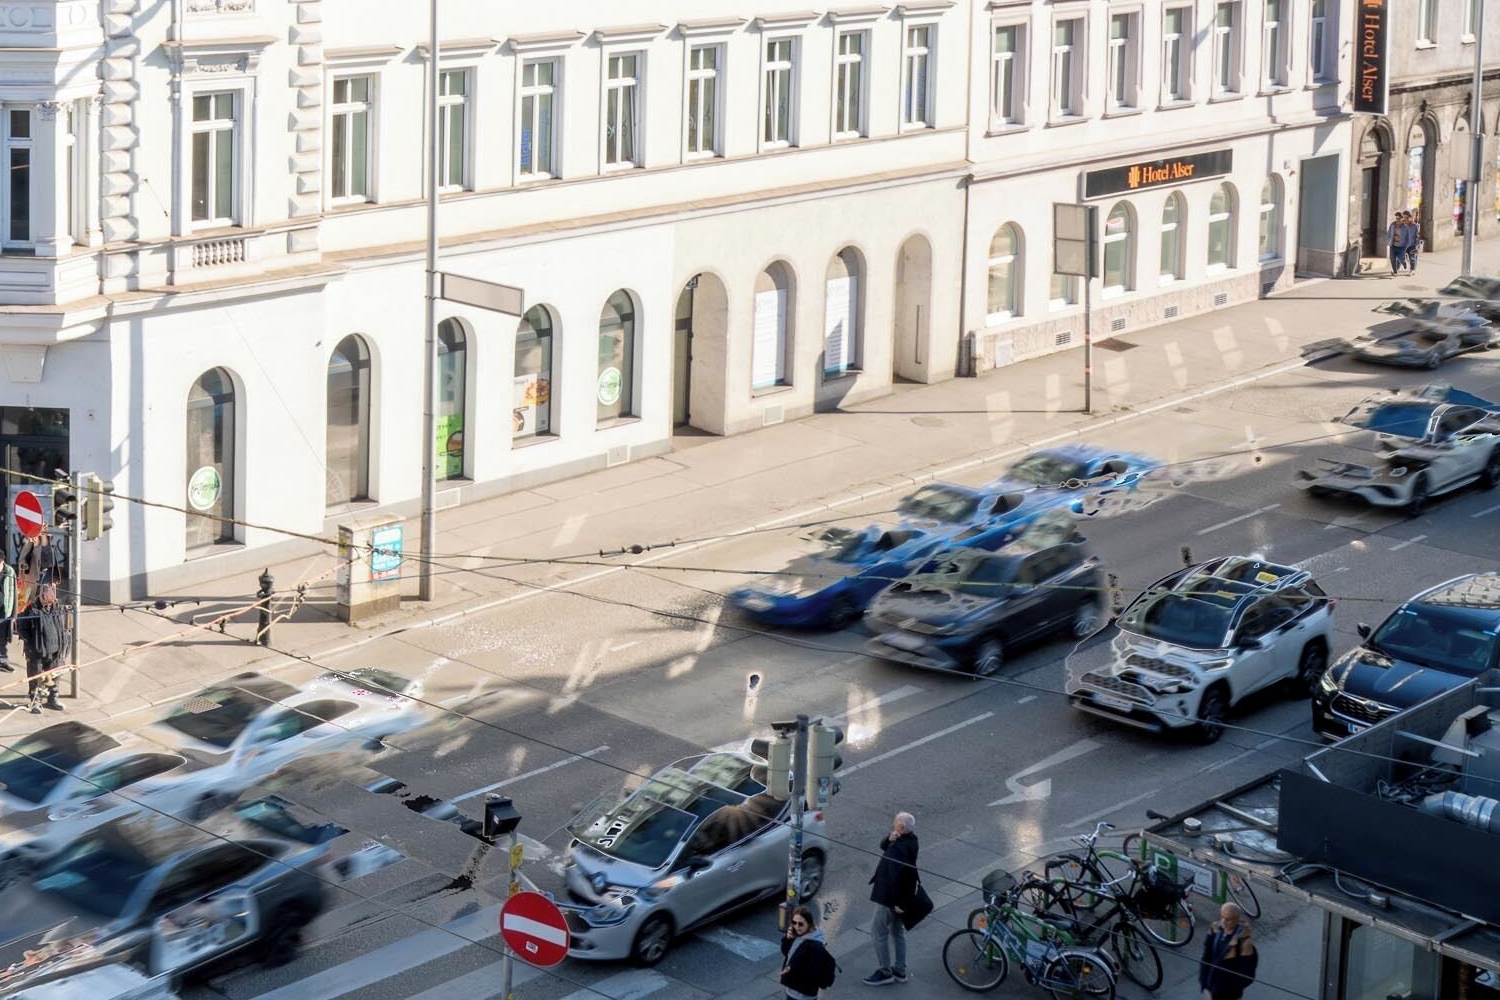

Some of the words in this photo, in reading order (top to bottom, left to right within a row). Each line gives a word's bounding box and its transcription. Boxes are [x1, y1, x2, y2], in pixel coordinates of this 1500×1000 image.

[1363, 13, 1381, 58] Hotel
[1361, 60, 1379, 102] Alser
[1142, 164, 1170, 184] Hotel
[1170, 162, 1195, 180] Alser
